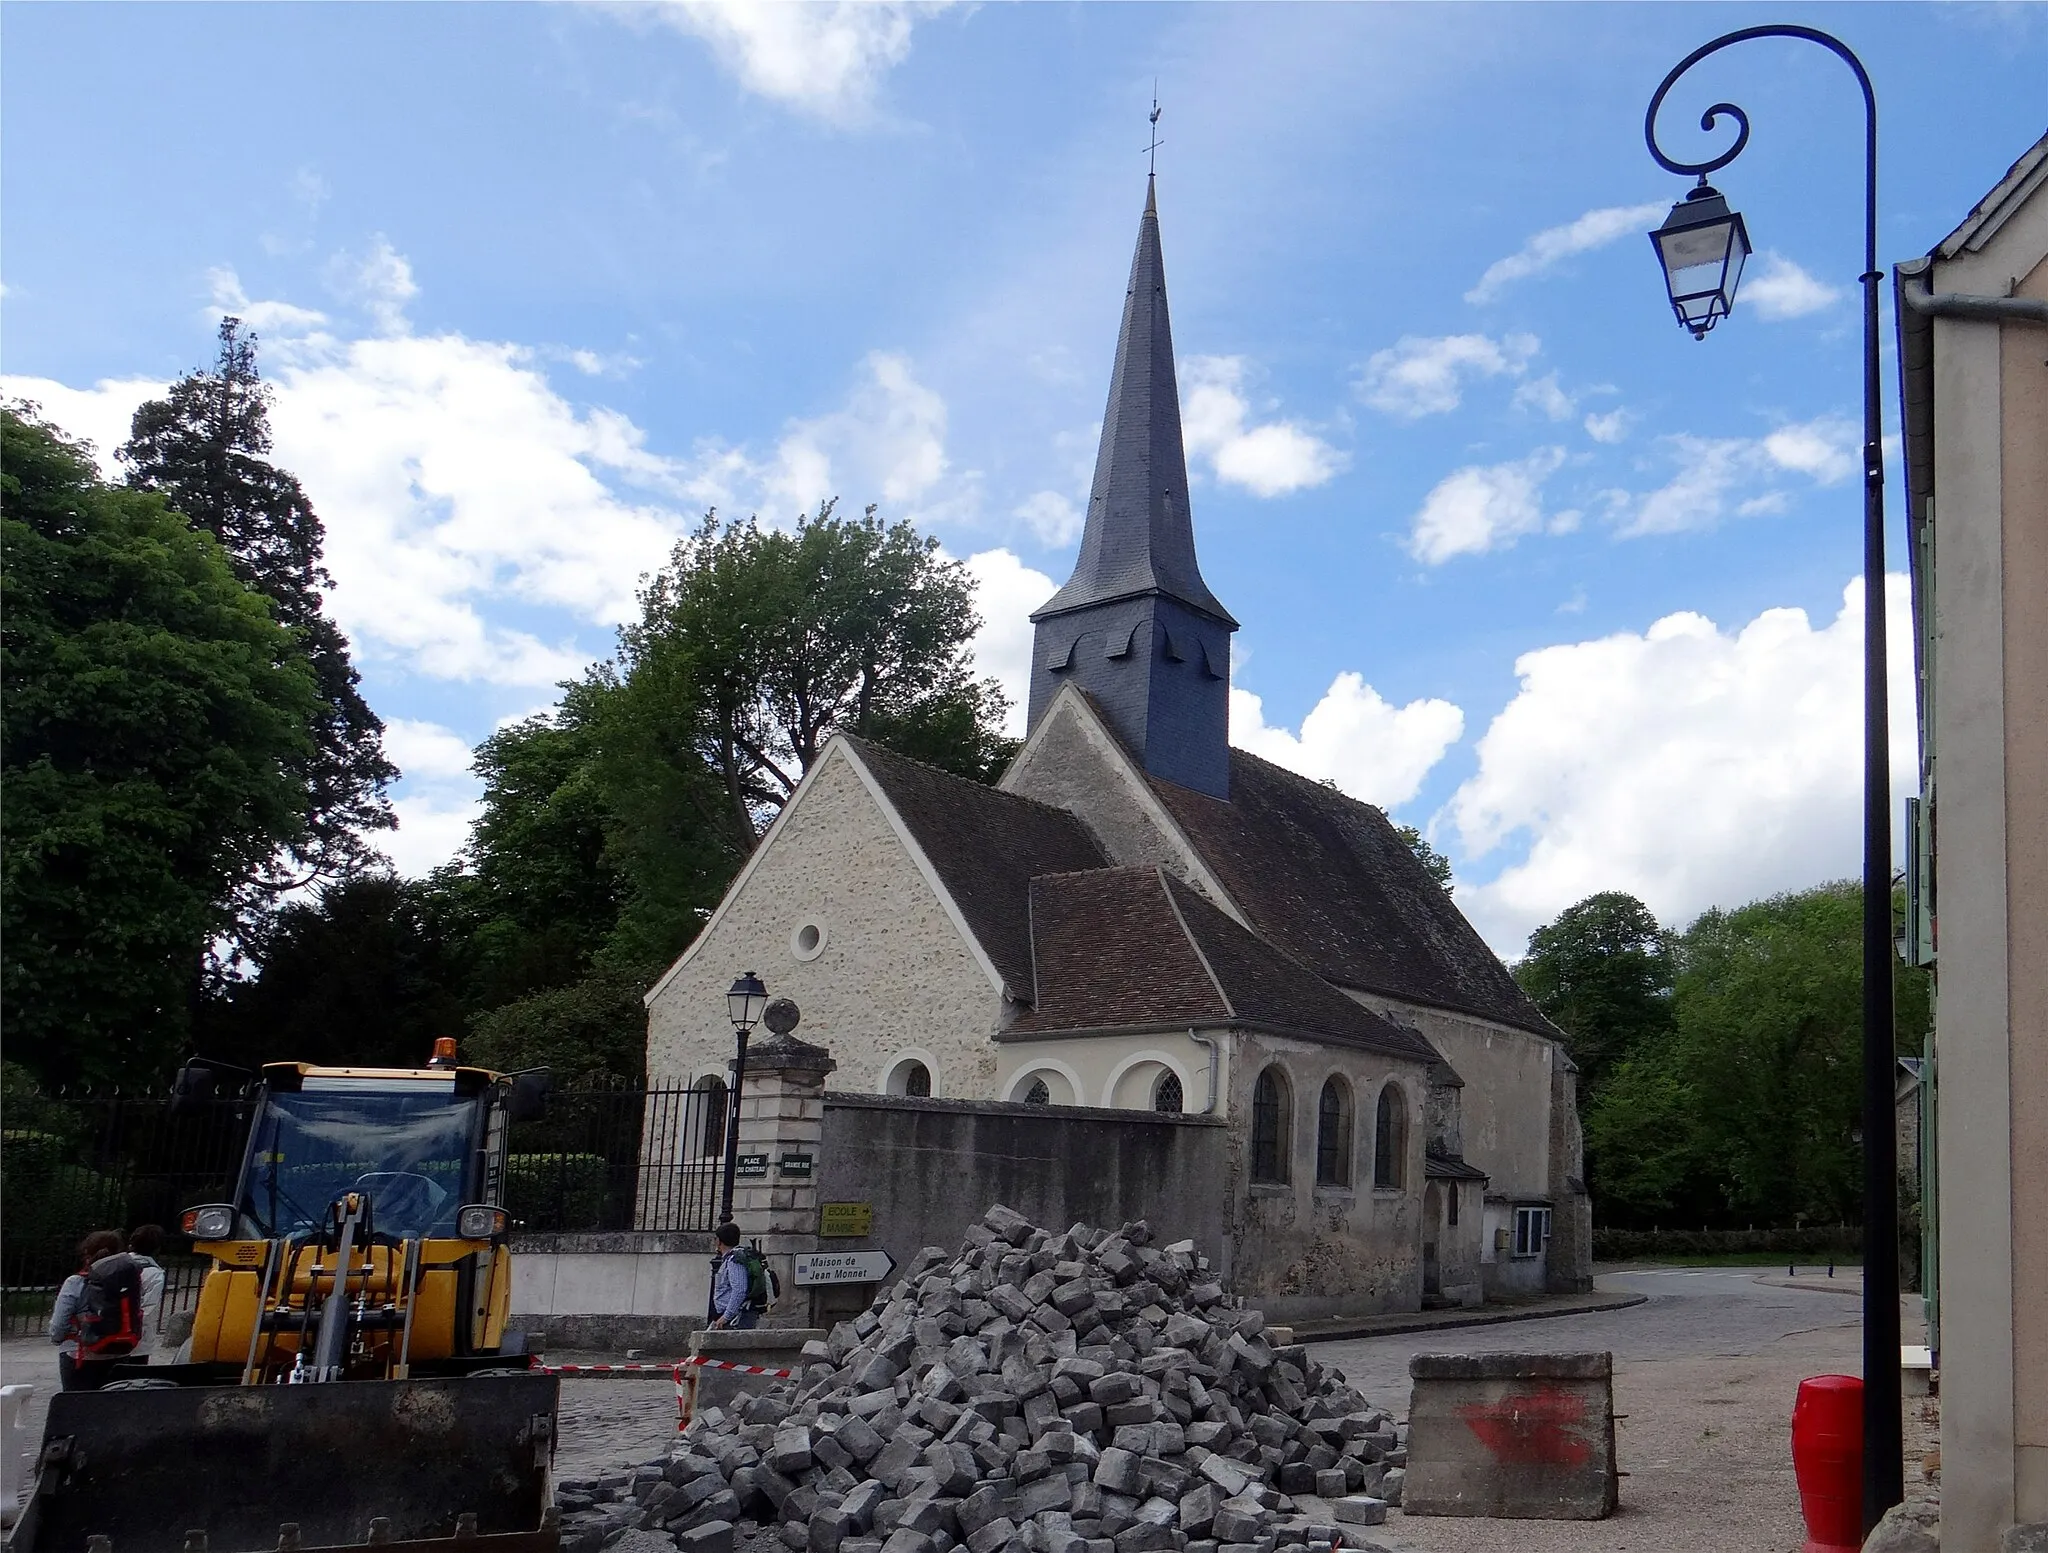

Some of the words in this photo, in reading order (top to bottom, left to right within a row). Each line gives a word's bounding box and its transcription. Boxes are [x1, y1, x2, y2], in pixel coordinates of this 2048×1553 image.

[743, 1157, 760, 1165] PLACE
[828, 1206, 857, 1216] ECOLE
[826, 1223, 855, 1233] MAIRIE
[810, 1257, 841, 1267] Maison
[845, 1256, 856, 1266] de
[809, 1270, 831, 1280] Jean
[834, 1269, 867, 1279] Monnet
